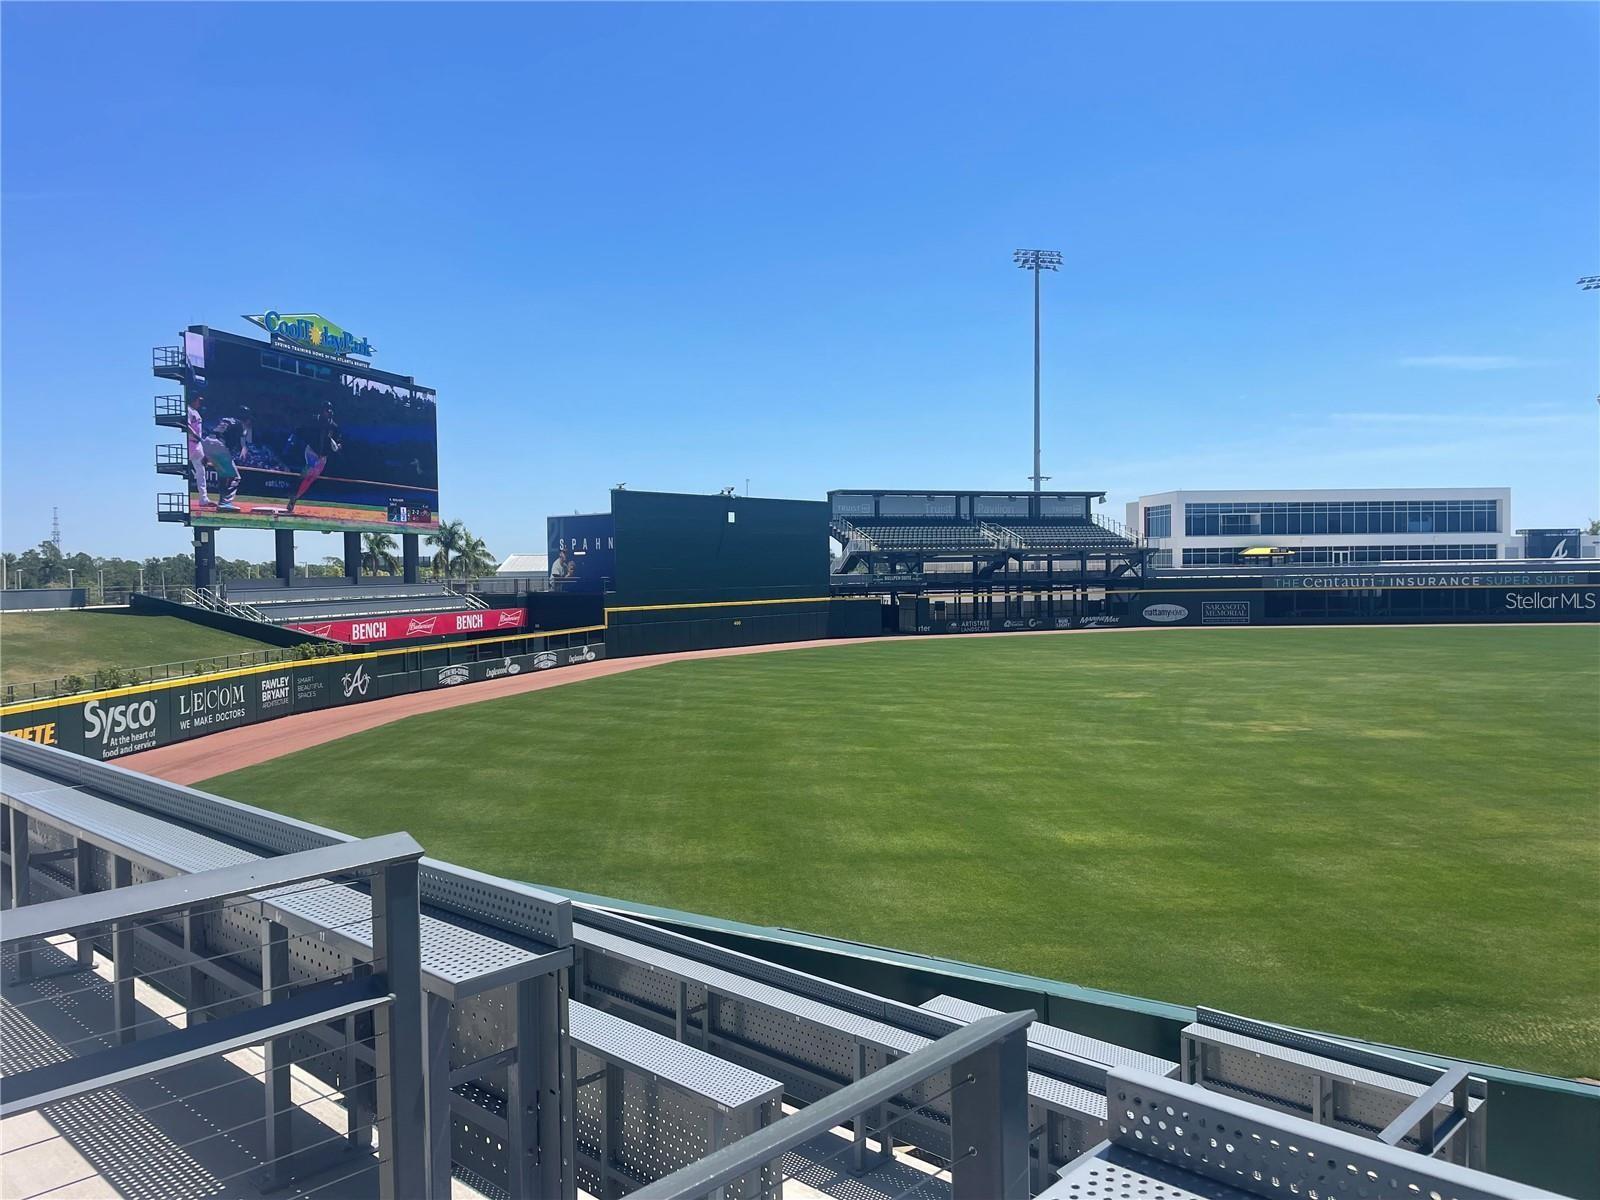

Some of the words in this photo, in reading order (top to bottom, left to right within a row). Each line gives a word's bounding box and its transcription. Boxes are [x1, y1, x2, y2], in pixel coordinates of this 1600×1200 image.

[274, 341, 291, 349] SPRING
[291, 345, 311, 355] TRAINING
[312, 350, 325, 358] HOME
[337, 357, 354, 365] ATLANTA
[559, 536, 614, 551] SPAHN
[1274, 578, 1300, 588] THE
[1302, 576, 1376, 588] Centauri
[1390, 576, 1480, 587] INSURANCE
[1486, 575, 1531, 586] SUPER
[1536, 574, 1575, 585] SUITE
[456, 613, 483, 630] BENCH
[352, 621, 387, 640] BENCH
[261, 676, 290, 691] FAWLEY
[297, 675, 315, 685] SMART
[297, 682, 324, 692] BEAUTIFUL
[261, 687, 290, 702] BRYANT
[297, 690, 317, 700] SPACES
[83, 699, 156, 744] Sysco
[180, 720, 191, 731] WE
[193, 714, 214, 728] MAKE
[215, 707, 246, 723] DOCTORS
[110, 736, 119, 747] At
[119, 734, 131, 744] the
[131, 731, 150, 743] heart
[149, 727, 157, 738] of
[102, 748, 119, 759] food
[119, 745, 134, 756] and
[134, 740, 157, 752] service
